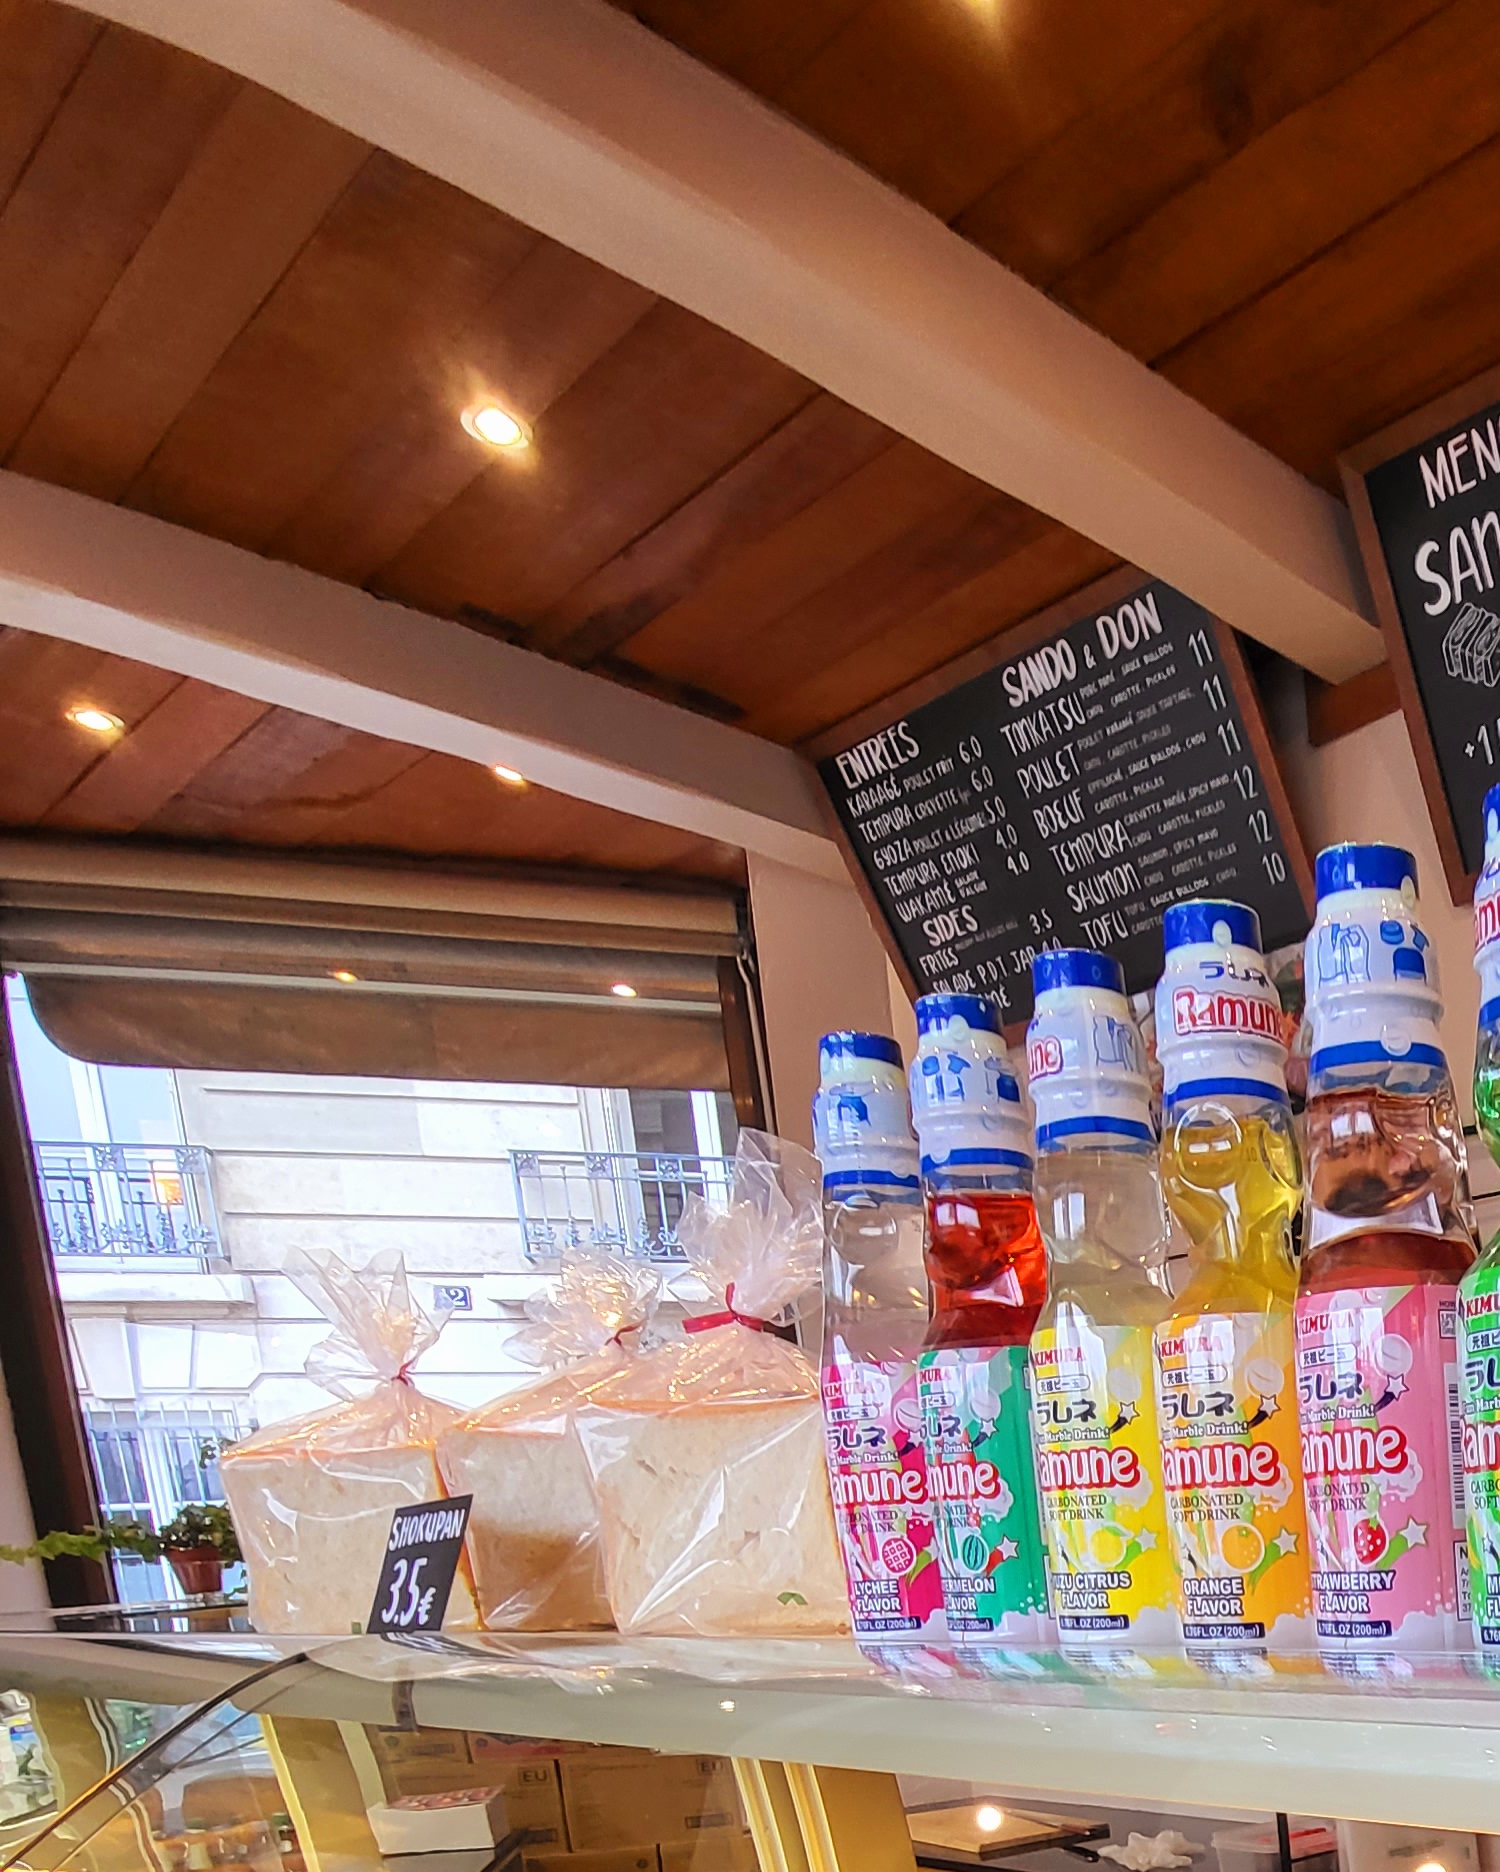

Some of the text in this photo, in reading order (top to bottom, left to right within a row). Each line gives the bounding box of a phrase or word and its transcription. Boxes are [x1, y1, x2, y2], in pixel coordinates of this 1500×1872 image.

[1002, 591, 1162, 708] SANDO & DON
[1000, 629, 1213, 757] TONKATSU 11
[959, 735, 982, 764] 6.0
[1016, 674, 1227, 799] POULET 11
[1464, 725, 1495, 765] +1
[1033, 788, 1086, 840] BOEUF
[1217, 719, 1242, 756] 11
[858, 764, 994, 845] TEMPURA 6.0
[984, 795, 1007, 825] 5.0
[1049, 765, 1258, 877] TEMPURA 12
[883, 823, 1018, 898] TEMPURA ENOKI 4.0
[1007, 850, 1030, 877] 4.0
[1067, 809, 1273, 914] SAUMON 12
[1080, 909, 1129, 949] TOFU
[1261, 851, 1287, 886] 10
[919, 907, 1053, 978] FRITES 3.5
[922, 904, 979, 947] SIDES
[389, 1509, 465, 1551] SHOKUPAN
[382, 1557, 436, 1627] 3.5€
[854, 1579, 899, 1596] LYCHEE
[1062, 1592, 1109, 1608] FLAVOR
[1075, 1573, 1130, 1588] CITRUS
[1184, 1579, 1243, 1595] ORANGE
[1312, 1572, 1394, 1590] TRAWBERRY
[857, 1597, 901, 1613] FLAVOR
[1187, 1599, 1242, 1615] FLAVOR
[1320, 1595, 1369, 1612] FLAVOR
[523, 1770, 547, 1783] EU
